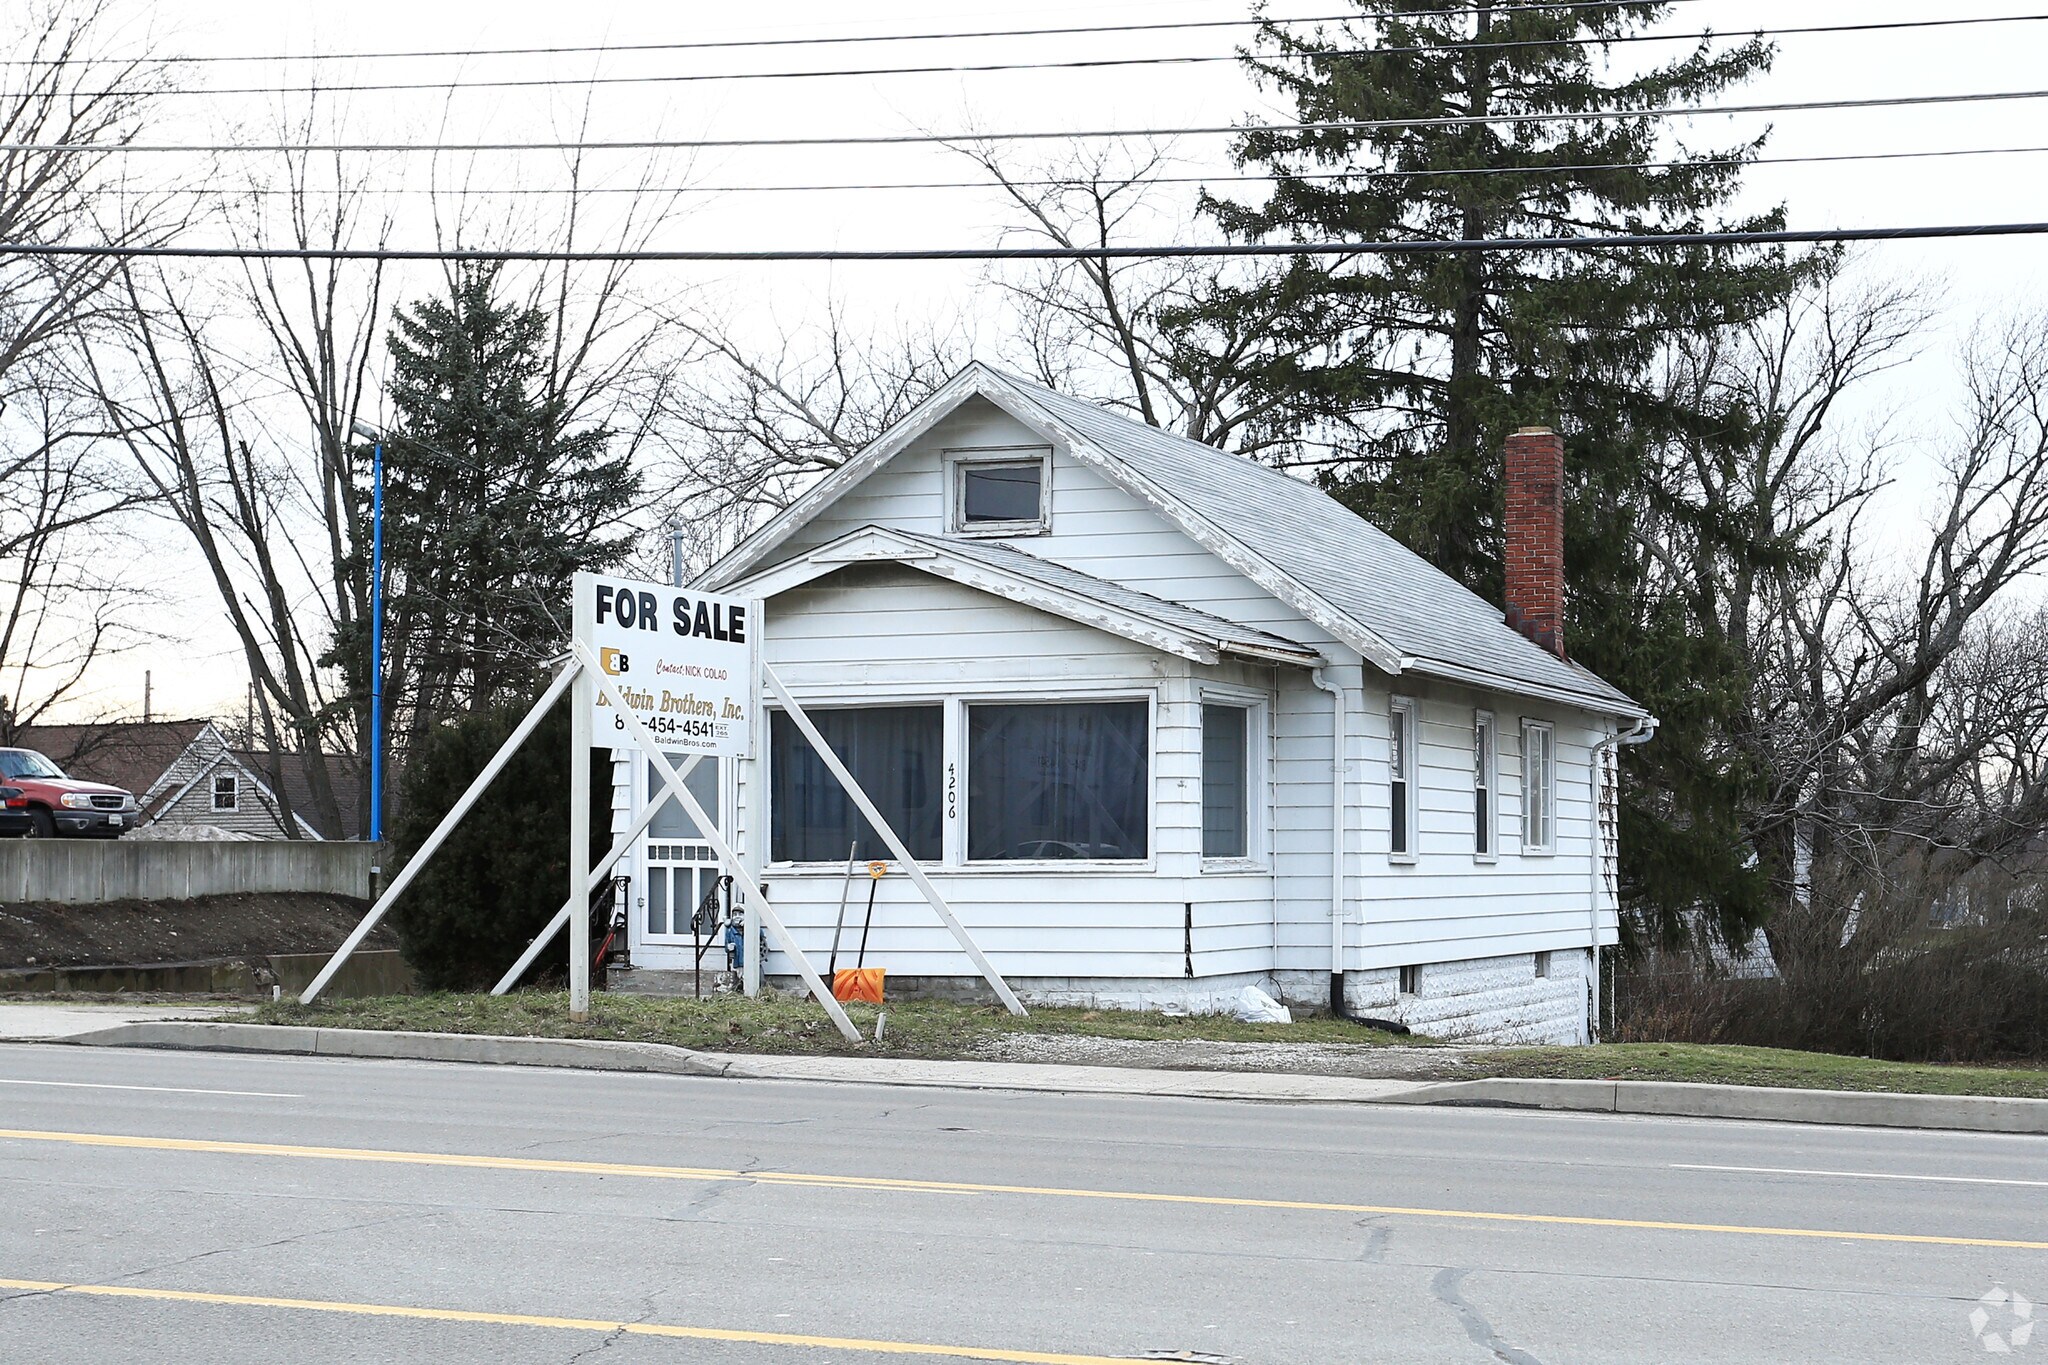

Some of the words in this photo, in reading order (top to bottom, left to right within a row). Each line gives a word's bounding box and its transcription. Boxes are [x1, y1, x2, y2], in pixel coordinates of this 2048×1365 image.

[597, 585, 658, 632] FOR
[673, 596, 745, 644] SALE
[656, 659, 684, 676] Contact:
[685, 665, 701, 678] NICK
[704, 667, 727, 680] COLAO
[596, 685, 654, 711] Bdwin
[659, 690, 716, 721] Brothers,
[721, 697, 744, 721] Inc.
[615, 714, 713, 737] 8-454-4541
[634, 736, 717, 748] BaldwinBros.com
[948, 763, 956, 819] 4206
